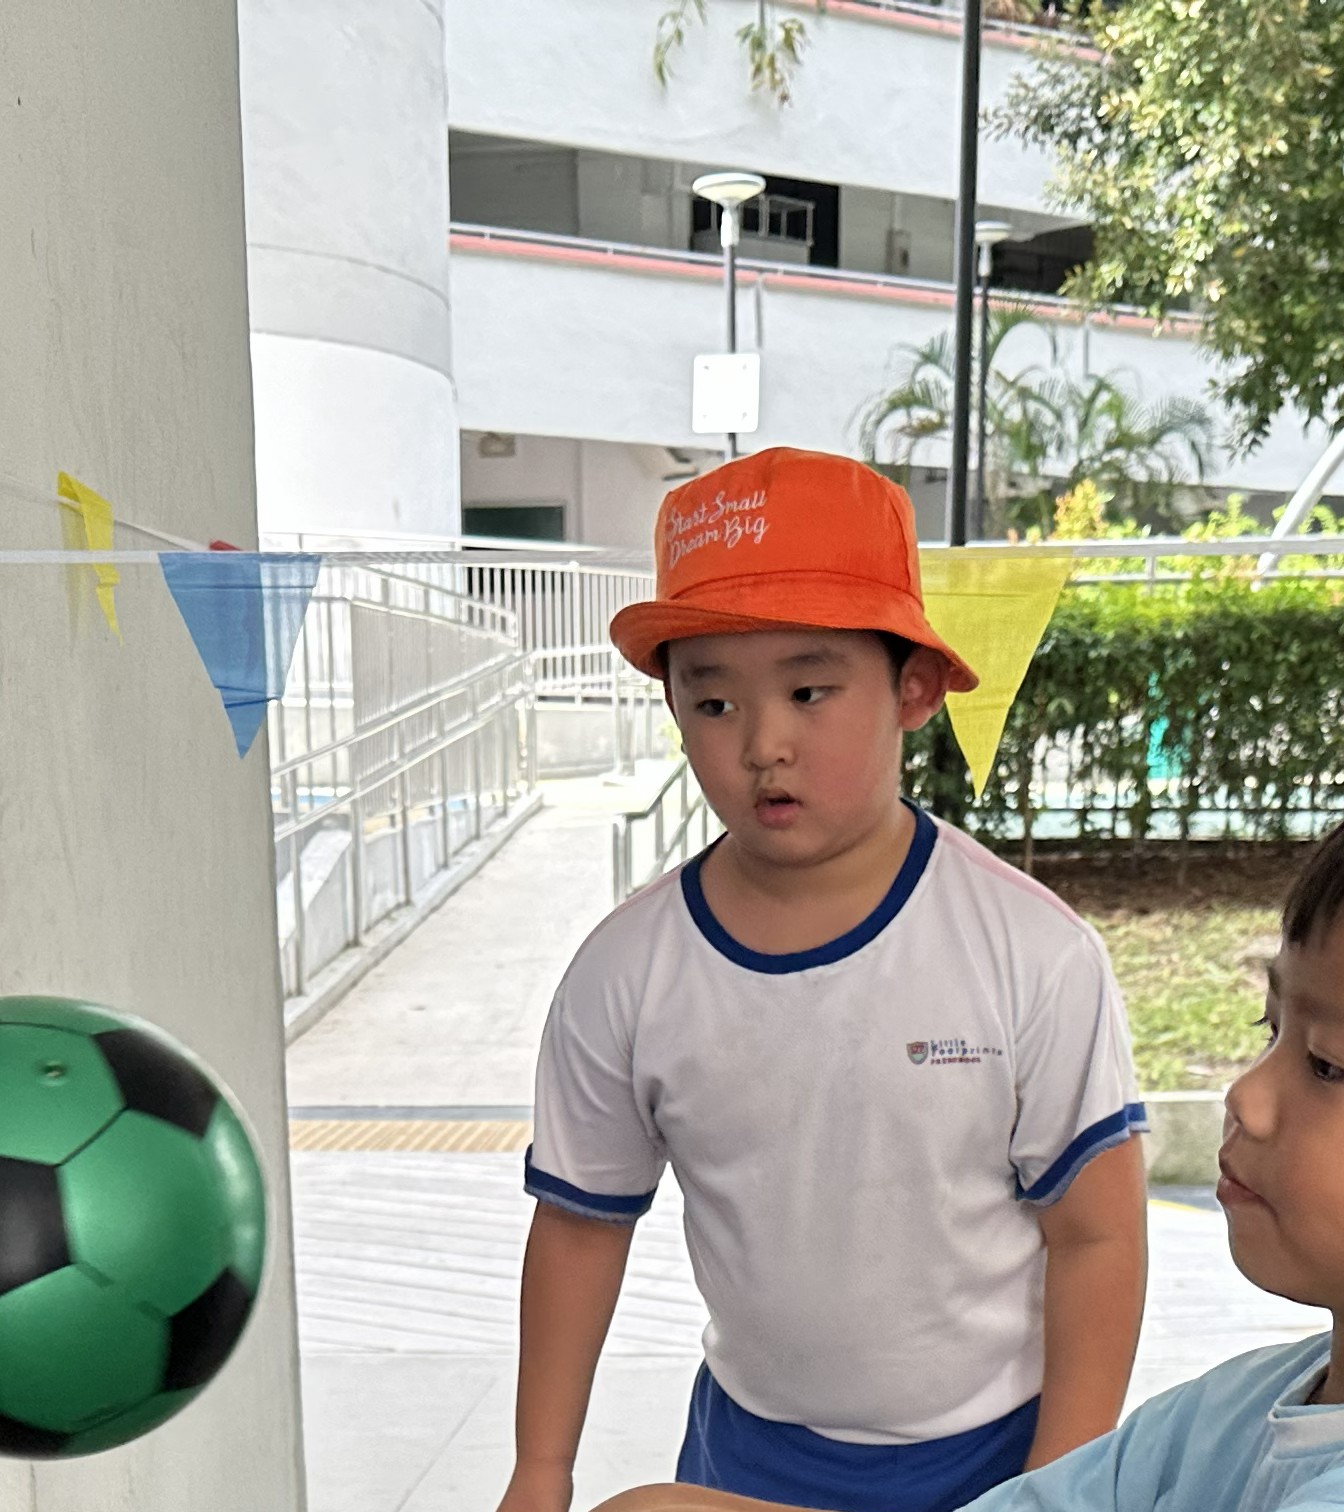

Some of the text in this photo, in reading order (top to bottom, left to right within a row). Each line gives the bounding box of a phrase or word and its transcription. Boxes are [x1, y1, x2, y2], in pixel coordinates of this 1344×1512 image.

[668, 490, 767, 542] Start Small
[669, 516, 770, 570] Dream Big
